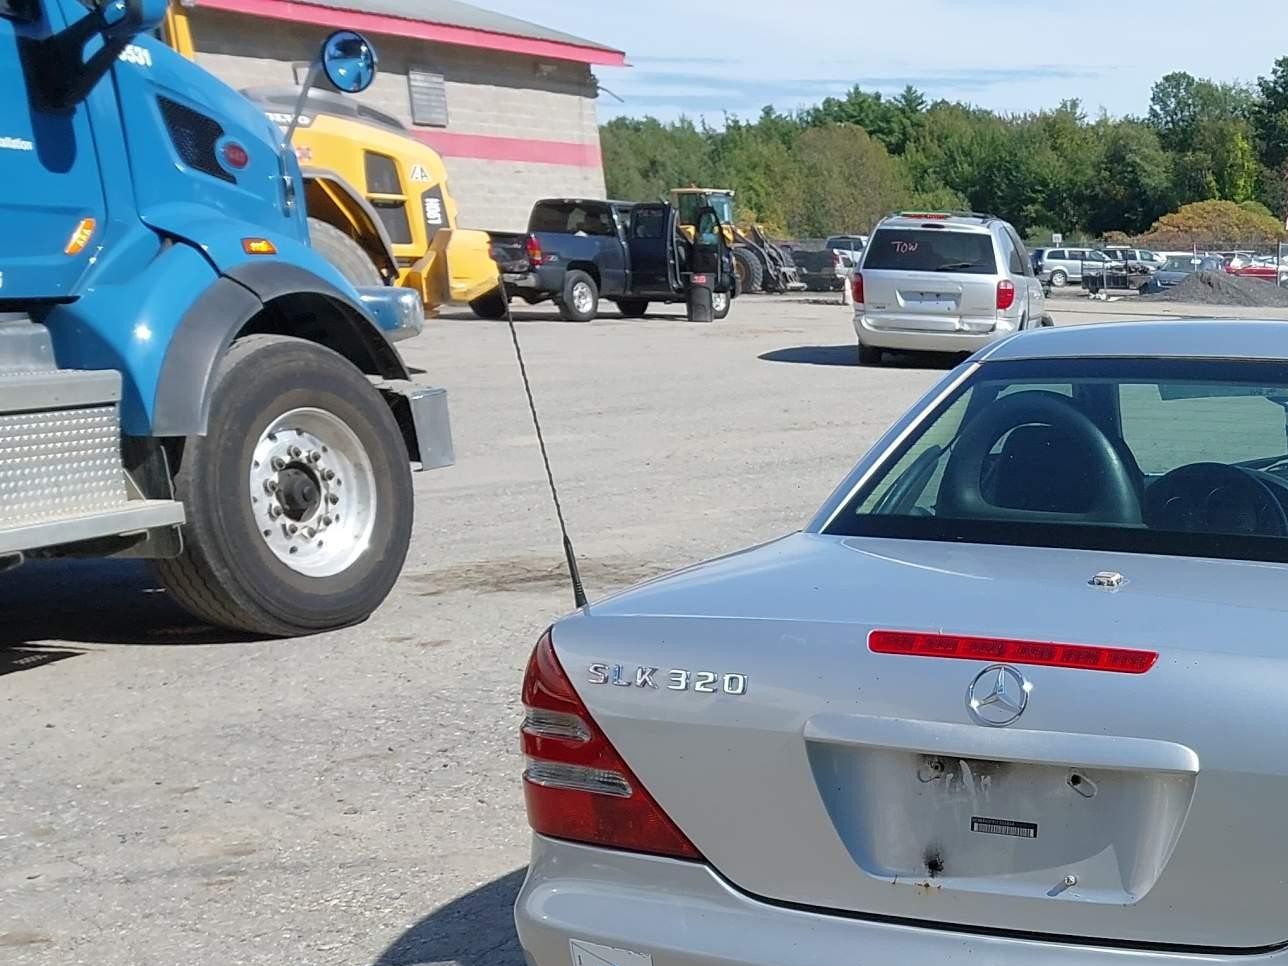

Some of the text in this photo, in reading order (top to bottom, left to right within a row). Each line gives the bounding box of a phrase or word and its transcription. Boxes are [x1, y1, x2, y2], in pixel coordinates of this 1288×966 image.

[891, 240, 919, 254] TOW
[588, 662, 750, 696] SLK 320
